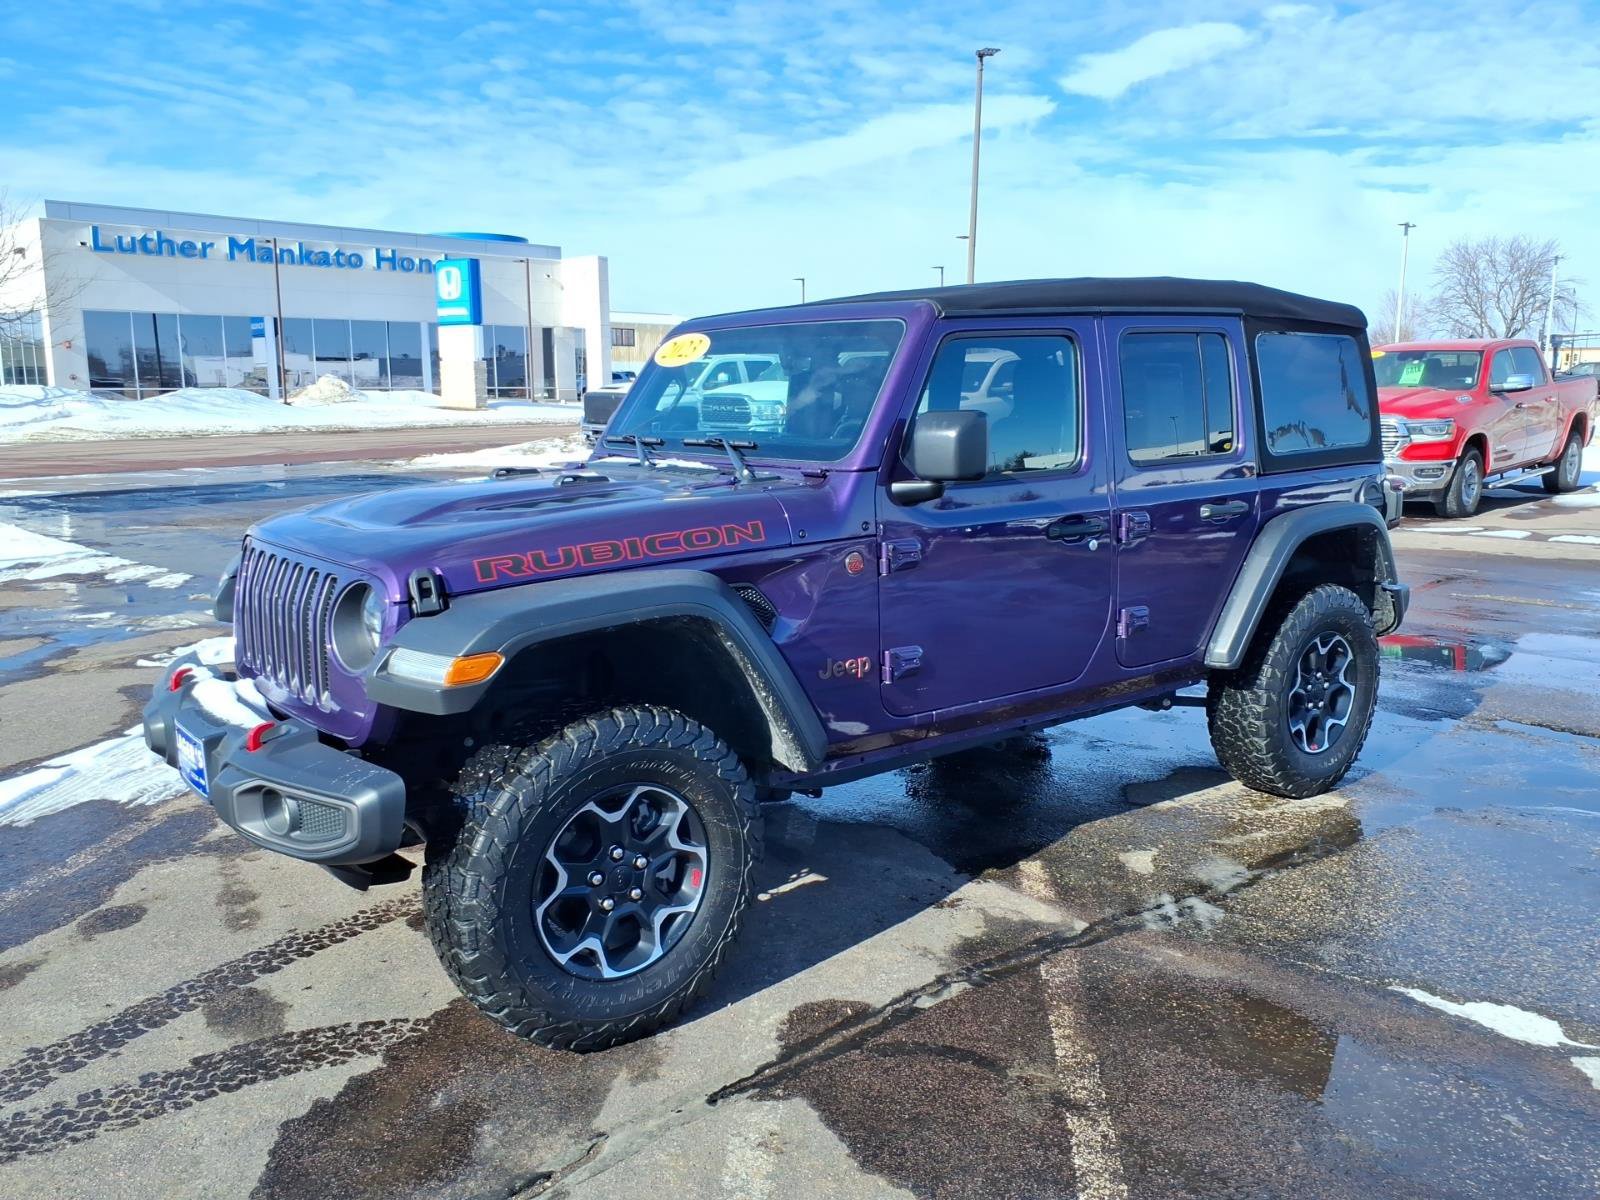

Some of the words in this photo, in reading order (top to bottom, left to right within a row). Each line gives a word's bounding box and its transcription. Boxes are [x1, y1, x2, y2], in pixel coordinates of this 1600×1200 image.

[90, 225, 215, 259] Luther
[227, 236, 364, 269] Mankato
[374, 247, 448, 274] Hon
[473, 520, 766, 583] RUBICON
[818, 656, 872, 680] Jeep
